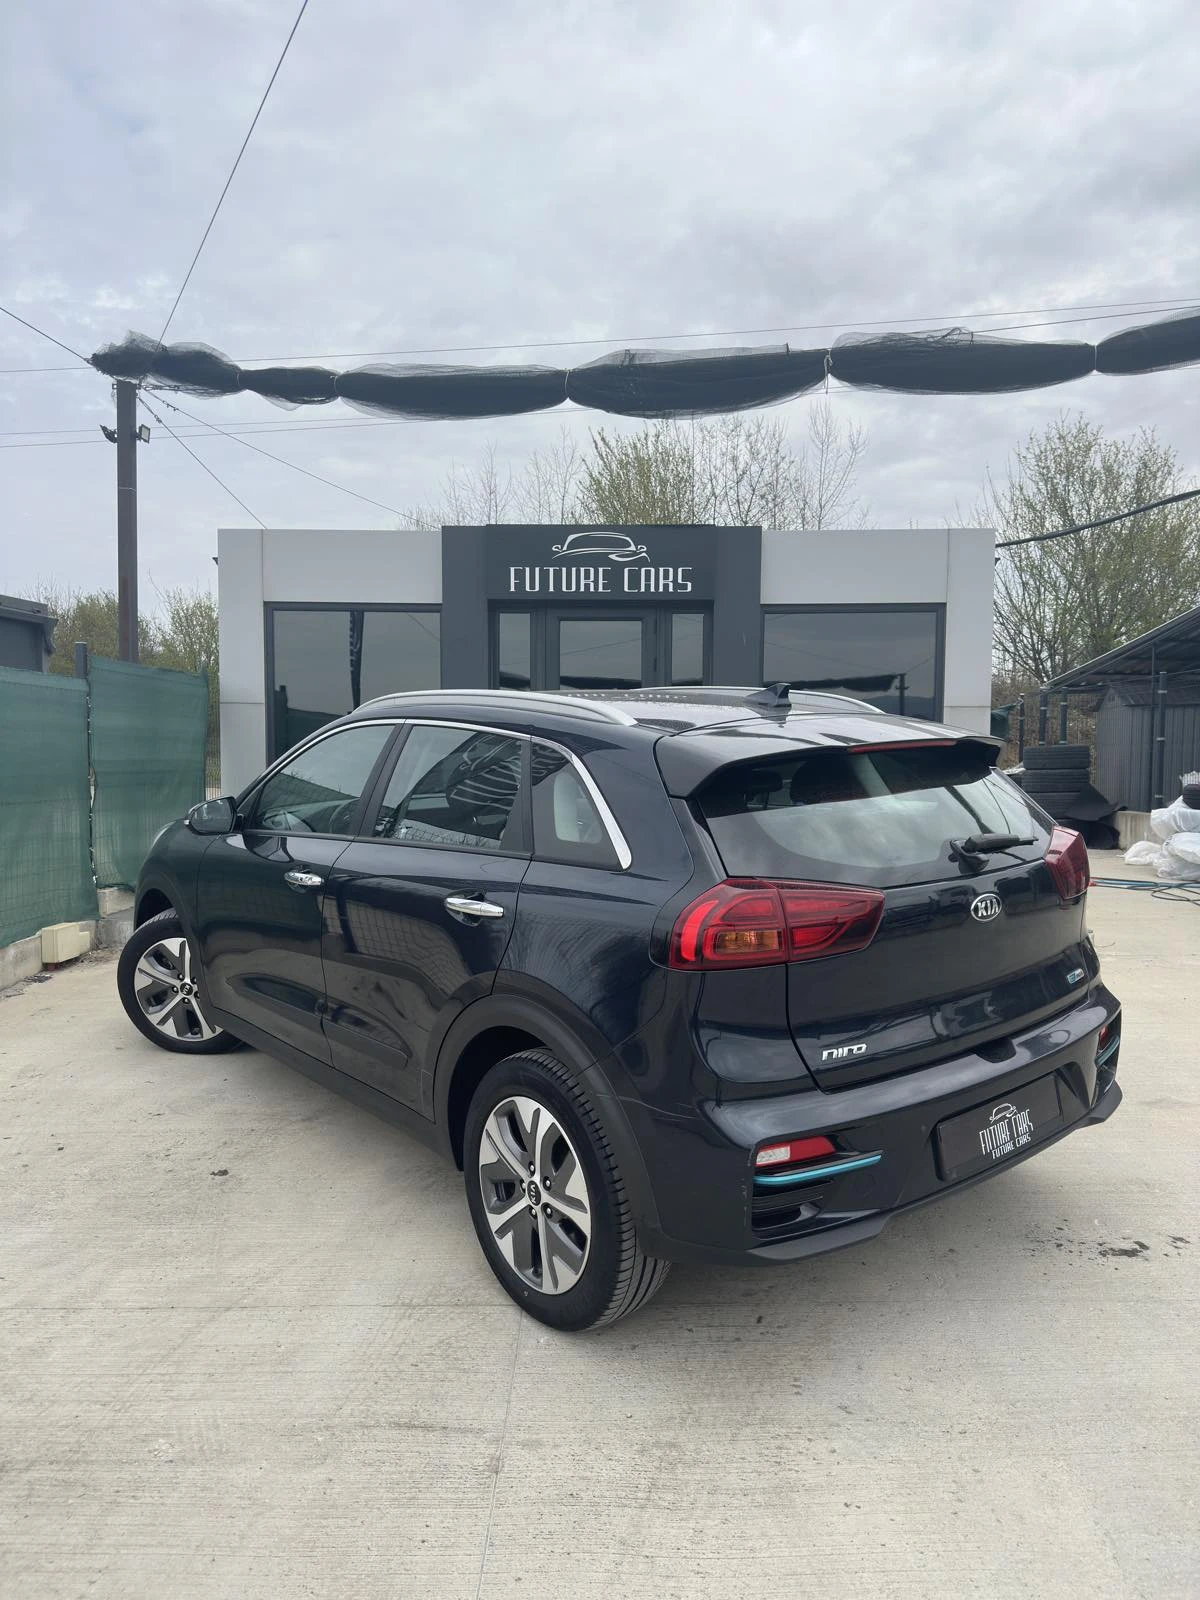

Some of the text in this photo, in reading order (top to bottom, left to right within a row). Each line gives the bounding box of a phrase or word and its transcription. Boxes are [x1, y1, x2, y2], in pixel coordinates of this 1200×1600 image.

[509, 566, 692, 592] FUTURE CARS
[977, 899, 999, 917] KIA
[979, 1109, 1034, 1155] FUTURE CARS
[992, 1133, 1031, 1159] FUTURE CARS
